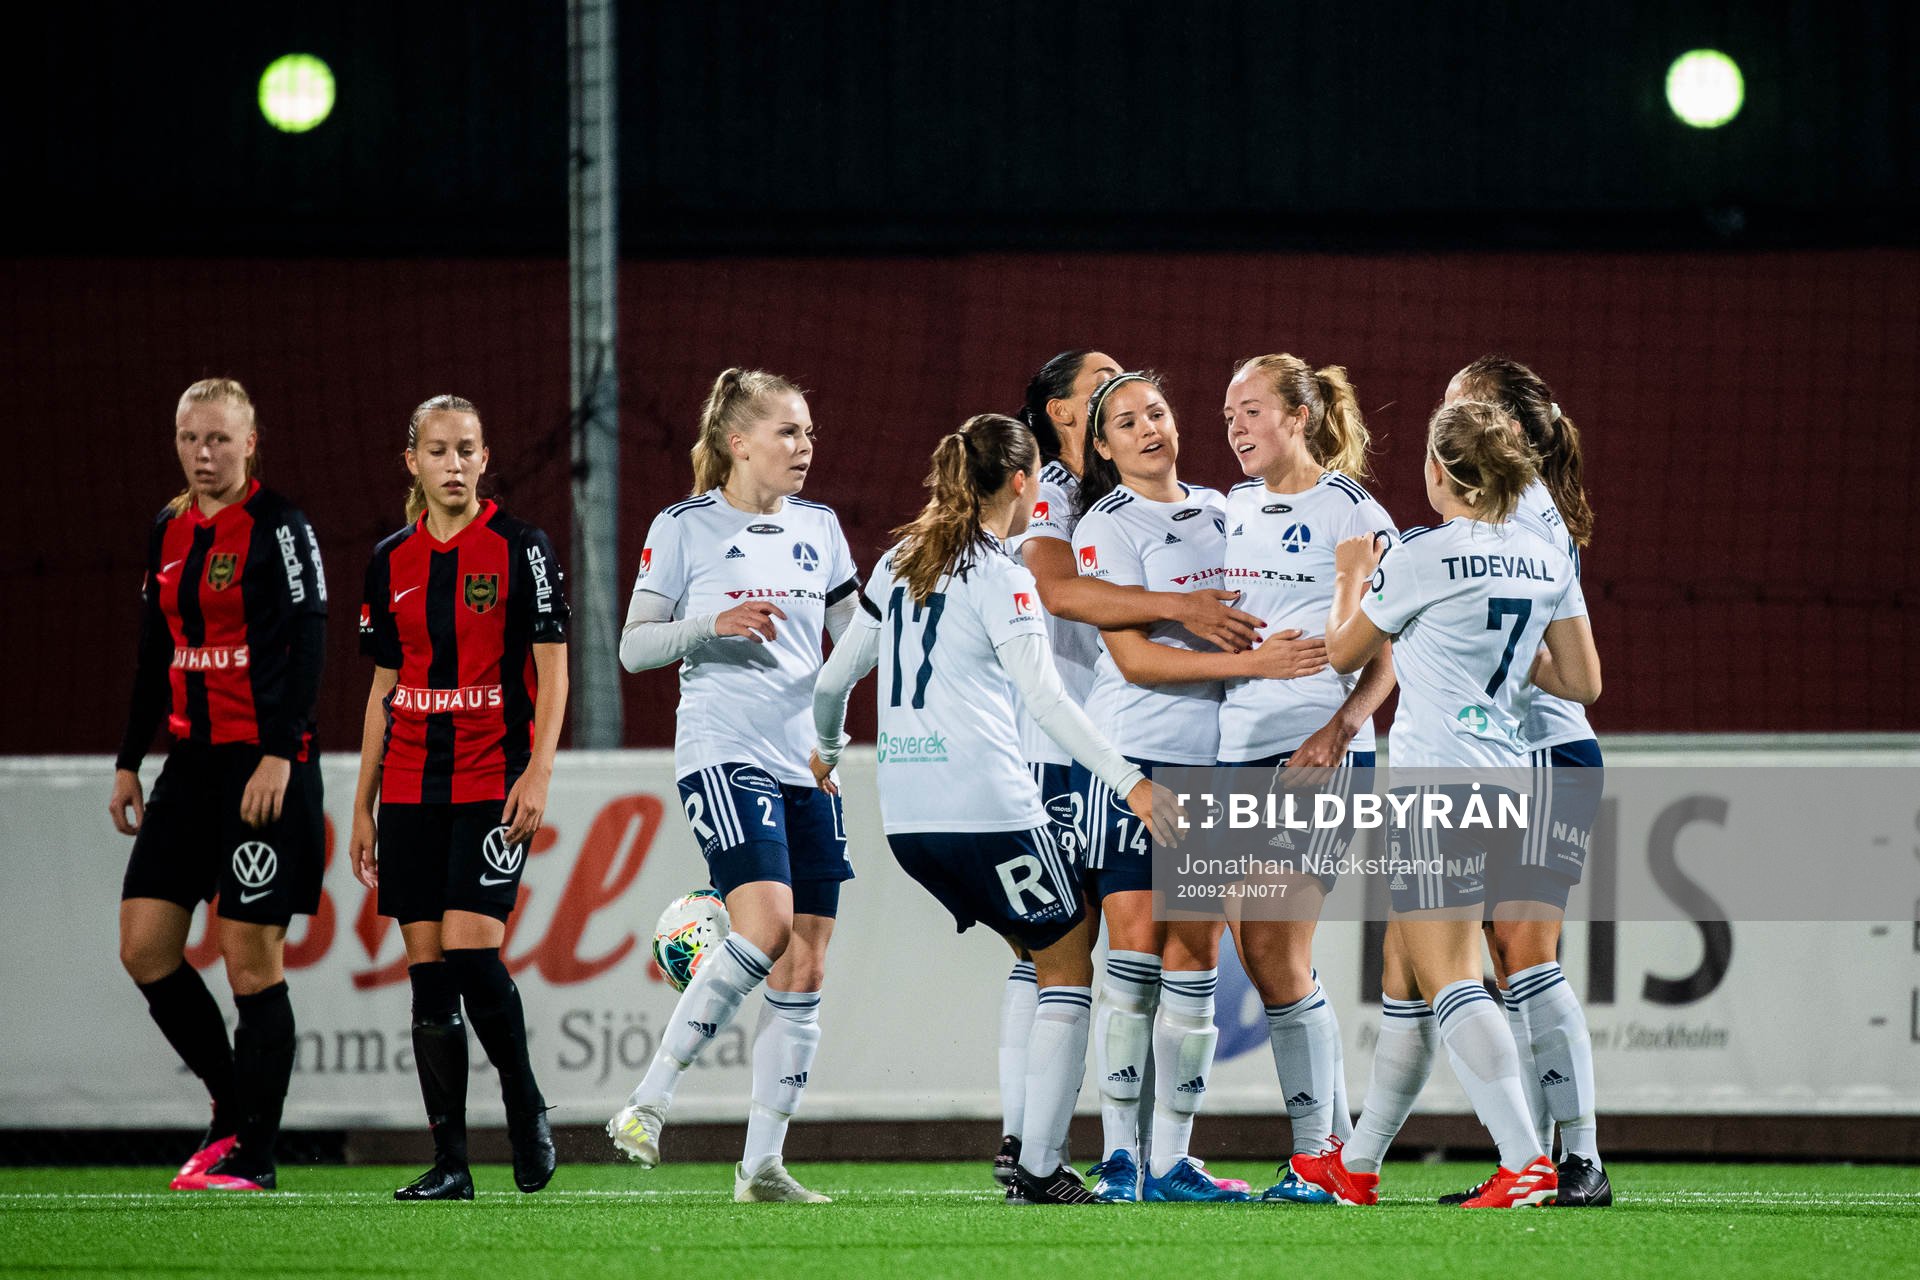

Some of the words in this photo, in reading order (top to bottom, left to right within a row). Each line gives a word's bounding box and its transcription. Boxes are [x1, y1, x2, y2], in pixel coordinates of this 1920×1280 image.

[276, 525, 305, 603] stadium
[1442, 555, 1555, 582] TIDEVALL
[888, 586, 946, 709] 17
[1486, 597, 1532, 699] 7
[889, 730, 947, 754] sverek
[685, 792, 716, 840] R
[757, 796, 776, 827] 2
[1116, 817, 1147, 855] 14
[995, 854, 1057, 915] R
